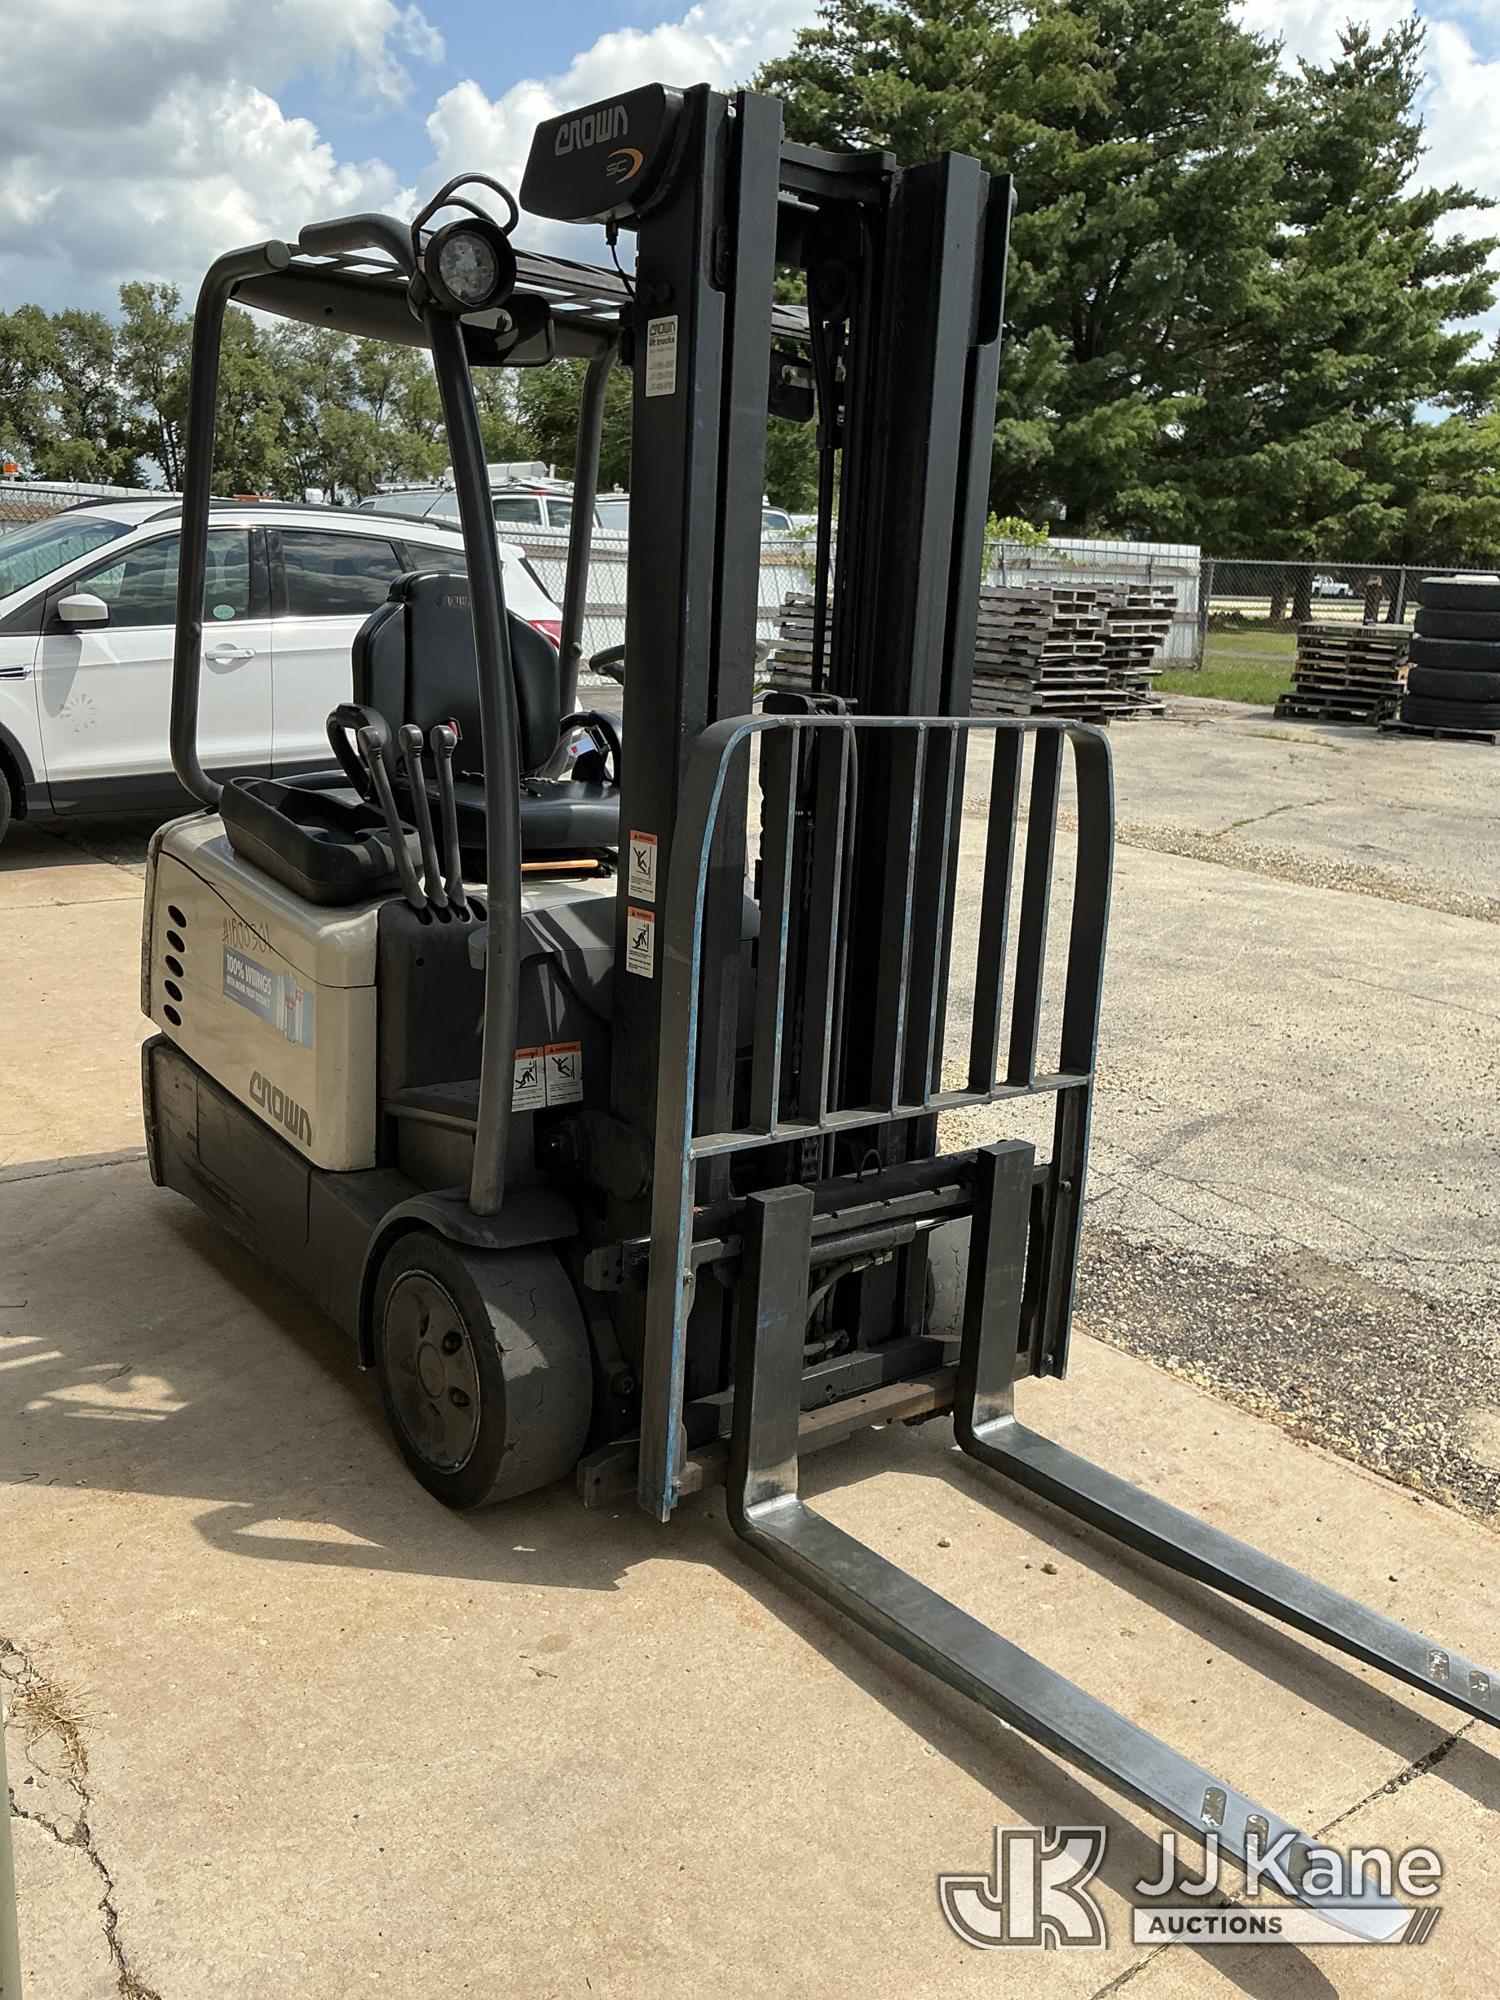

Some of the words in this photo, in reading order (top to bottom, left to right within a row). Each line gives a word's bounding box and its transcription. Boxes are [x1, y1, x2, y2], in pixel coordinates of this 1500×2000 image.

[554, 104, 628, 156] CROWN
[606, 158, 628, 177] SC
[249, 1070, 312, 1148] CROWN
